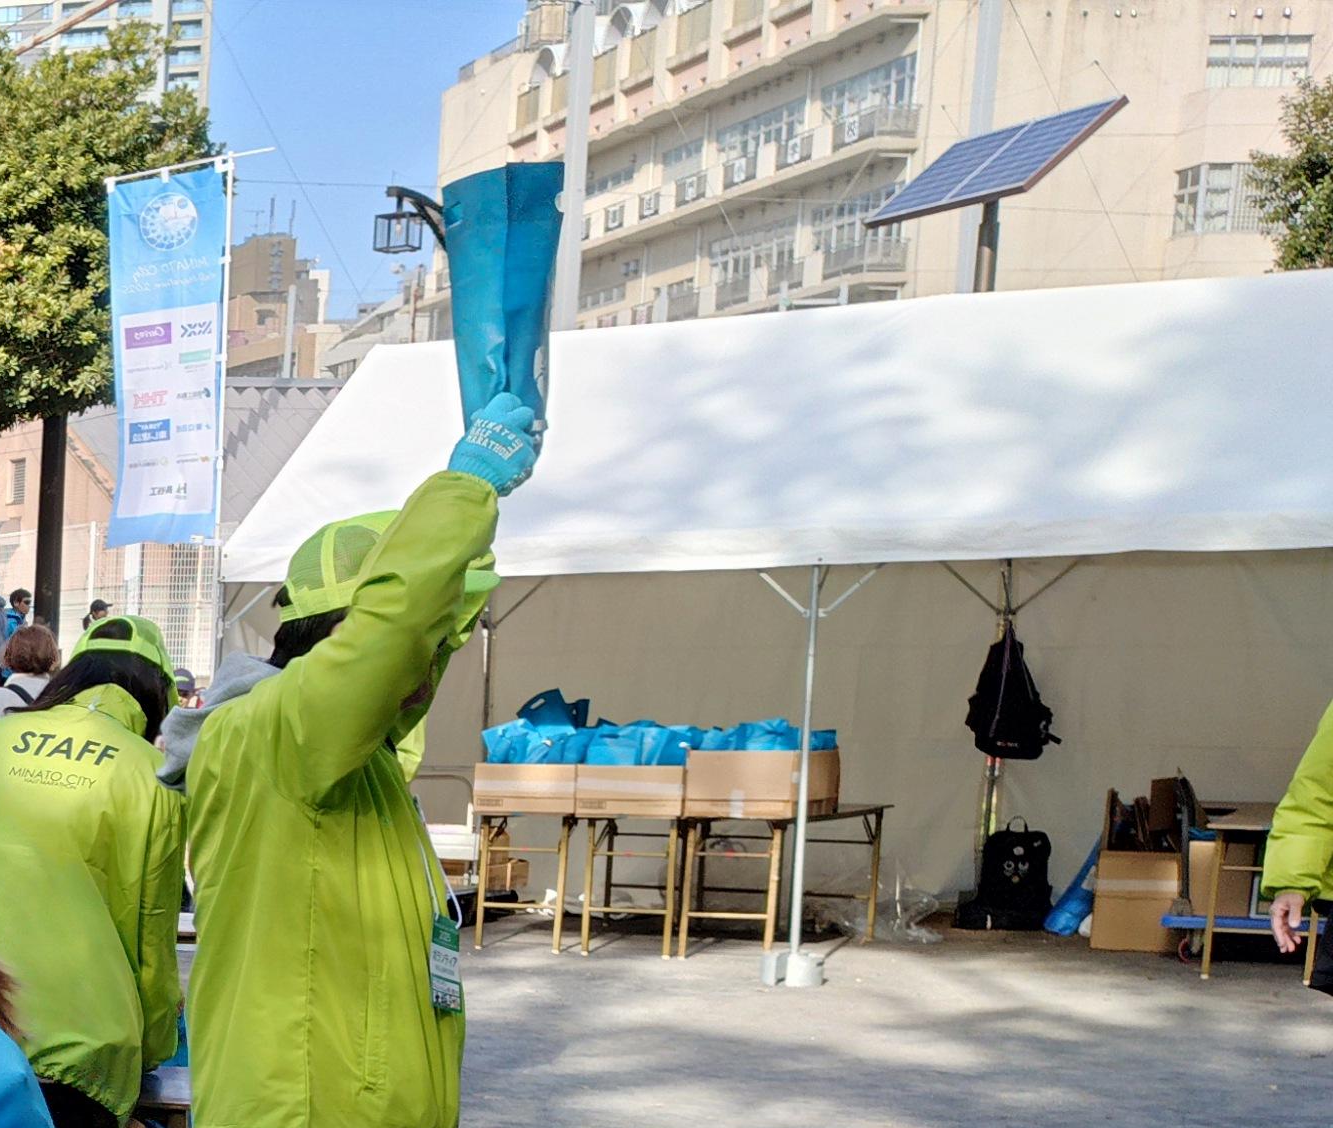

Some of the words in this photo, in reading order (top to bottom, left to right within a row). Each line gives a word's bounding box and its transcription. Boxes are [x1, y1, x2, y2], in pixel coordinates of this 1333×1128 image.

[12, 730, 120, 767] STAFF
[8, 766, 63, 782] MINATO
[66, 773, 97, 789] CITY
